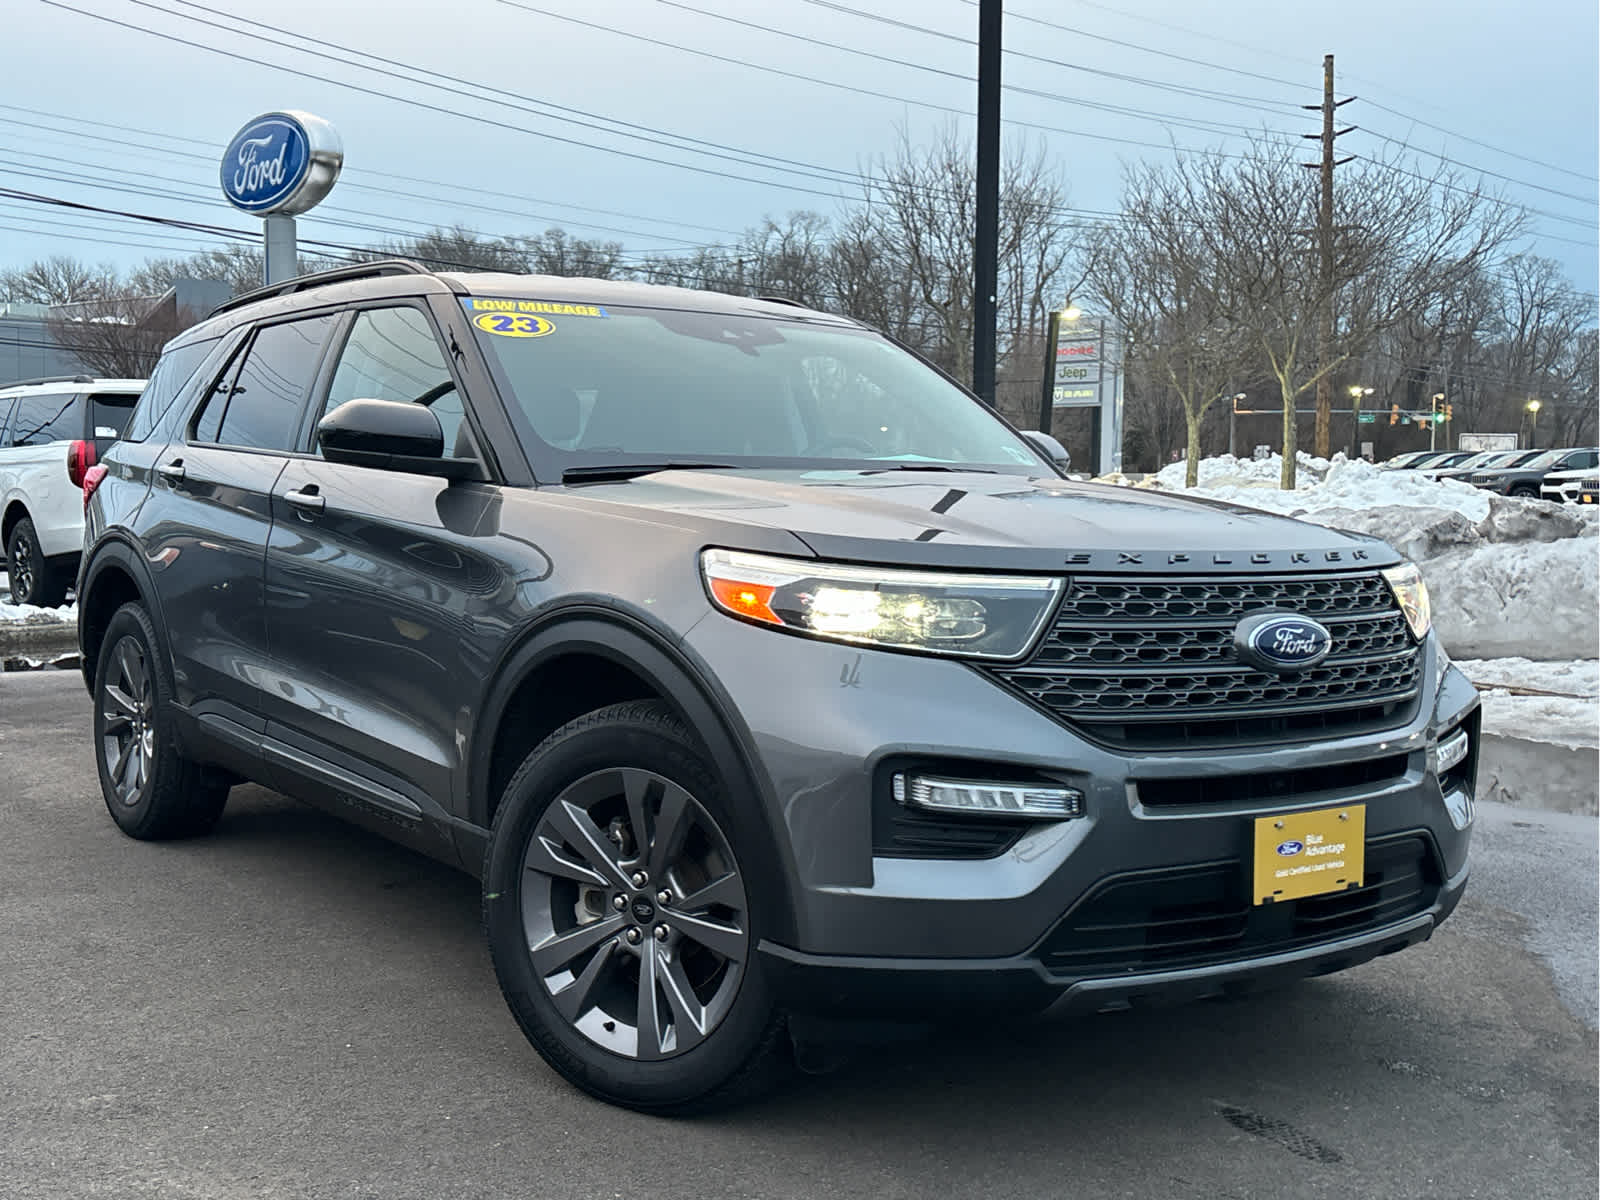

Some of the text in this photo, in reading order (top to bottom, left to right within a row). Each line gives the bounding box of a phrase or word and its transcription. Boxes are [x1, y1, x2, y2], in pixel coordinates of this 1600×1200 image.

[233, 134, 287, 195] Ford
[472, 299, 602, 317] LOW MILEAGE
[491, 315, 540, 333] 23
[1059, 366, 1087, 379] Jeep
[1064, 550, 1370, 565] EXPLORER
[1273, 627, 1317, 654] Ford
[1306, 834, 1323, 845] Blue
[1281, 842, 1300, 855] Ford
[1305, 843, 1345, 856] Advantage
